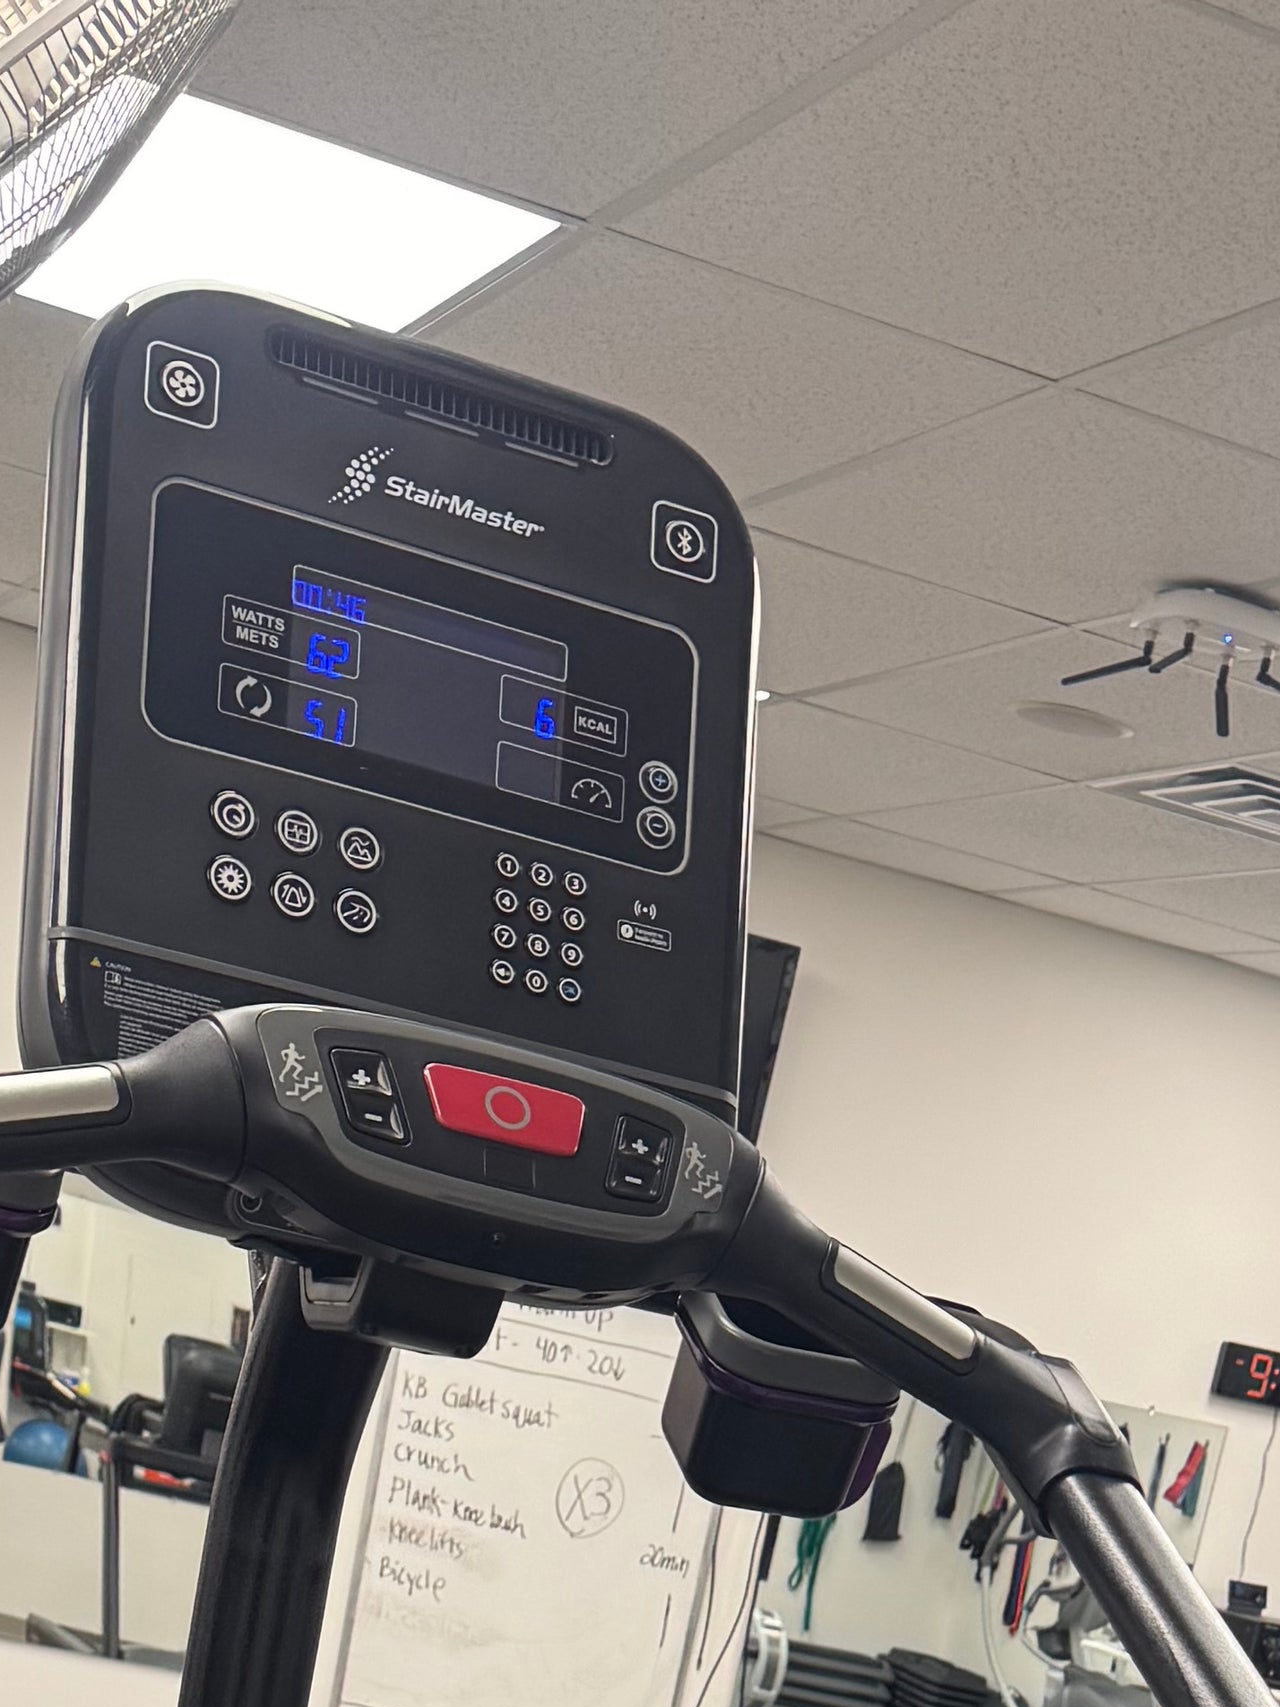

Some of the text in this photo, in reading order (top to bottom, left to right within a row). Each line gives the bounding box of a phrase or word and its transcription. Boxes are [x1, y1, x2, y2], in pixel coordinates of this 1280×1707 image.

[384, 475, 541, 537] StairMaster
[231, 604, 285, 632] WATTS
[235, 626, 279, 649] METS
[306, 632, 350, 679] 62
[304, 699, 347, 744] 51
[534, 698, 556, 740] 6
[578, 716, 613, 735] KCAL
[538, 869, 547, 881] 2
[571, 879, 580, 889] 3
[501, 896, 578, 925] 4 5 6
[501, 931, 576, 960] 7 8 9
[532, 976, 541, 987] 0
